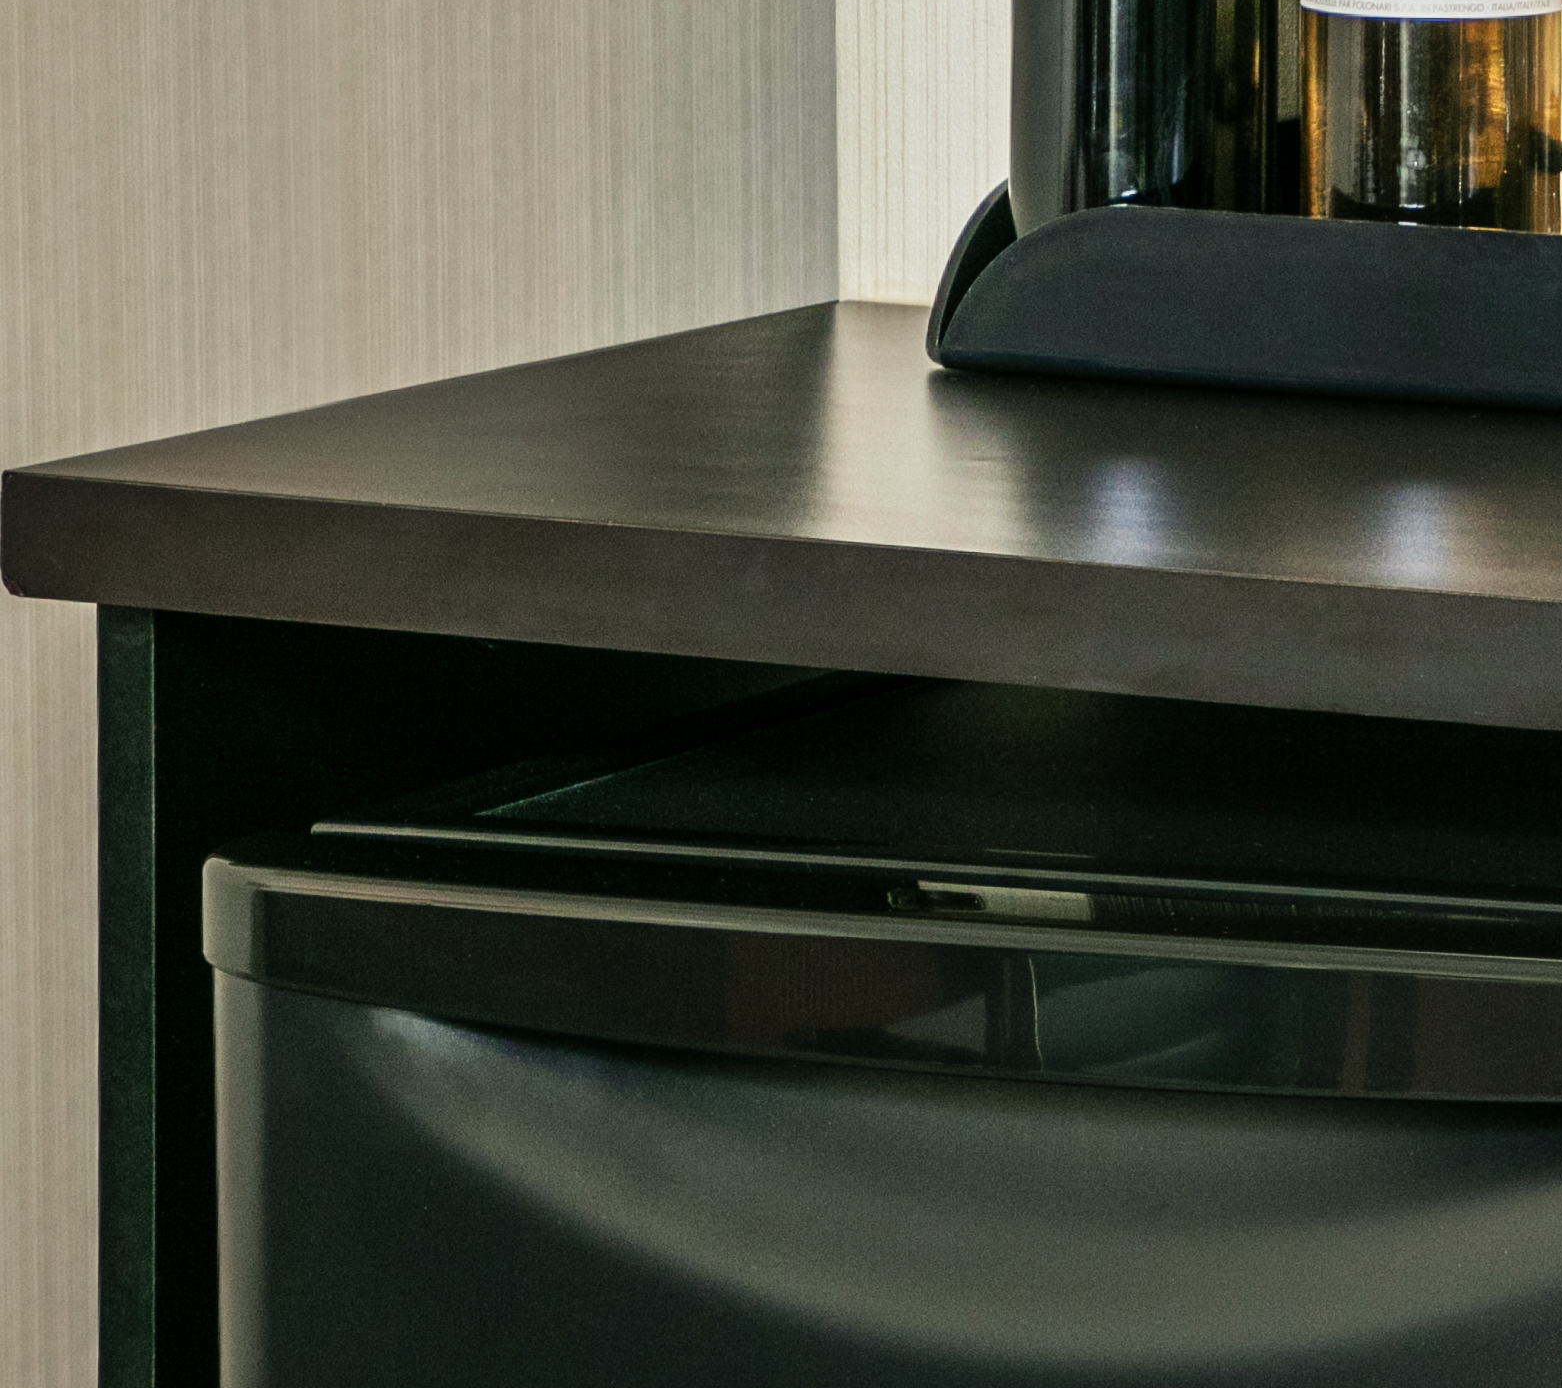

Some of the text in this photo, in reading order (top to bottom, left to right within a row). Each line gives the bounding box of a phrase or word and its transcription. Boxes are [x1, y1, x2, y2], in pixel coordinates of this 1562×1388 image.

[1339, 0, 1351, 8] PAR
[1352, 0, 1392, 11] FOLONARI
[1432, 2, 1485, 13] PASTRENGO
